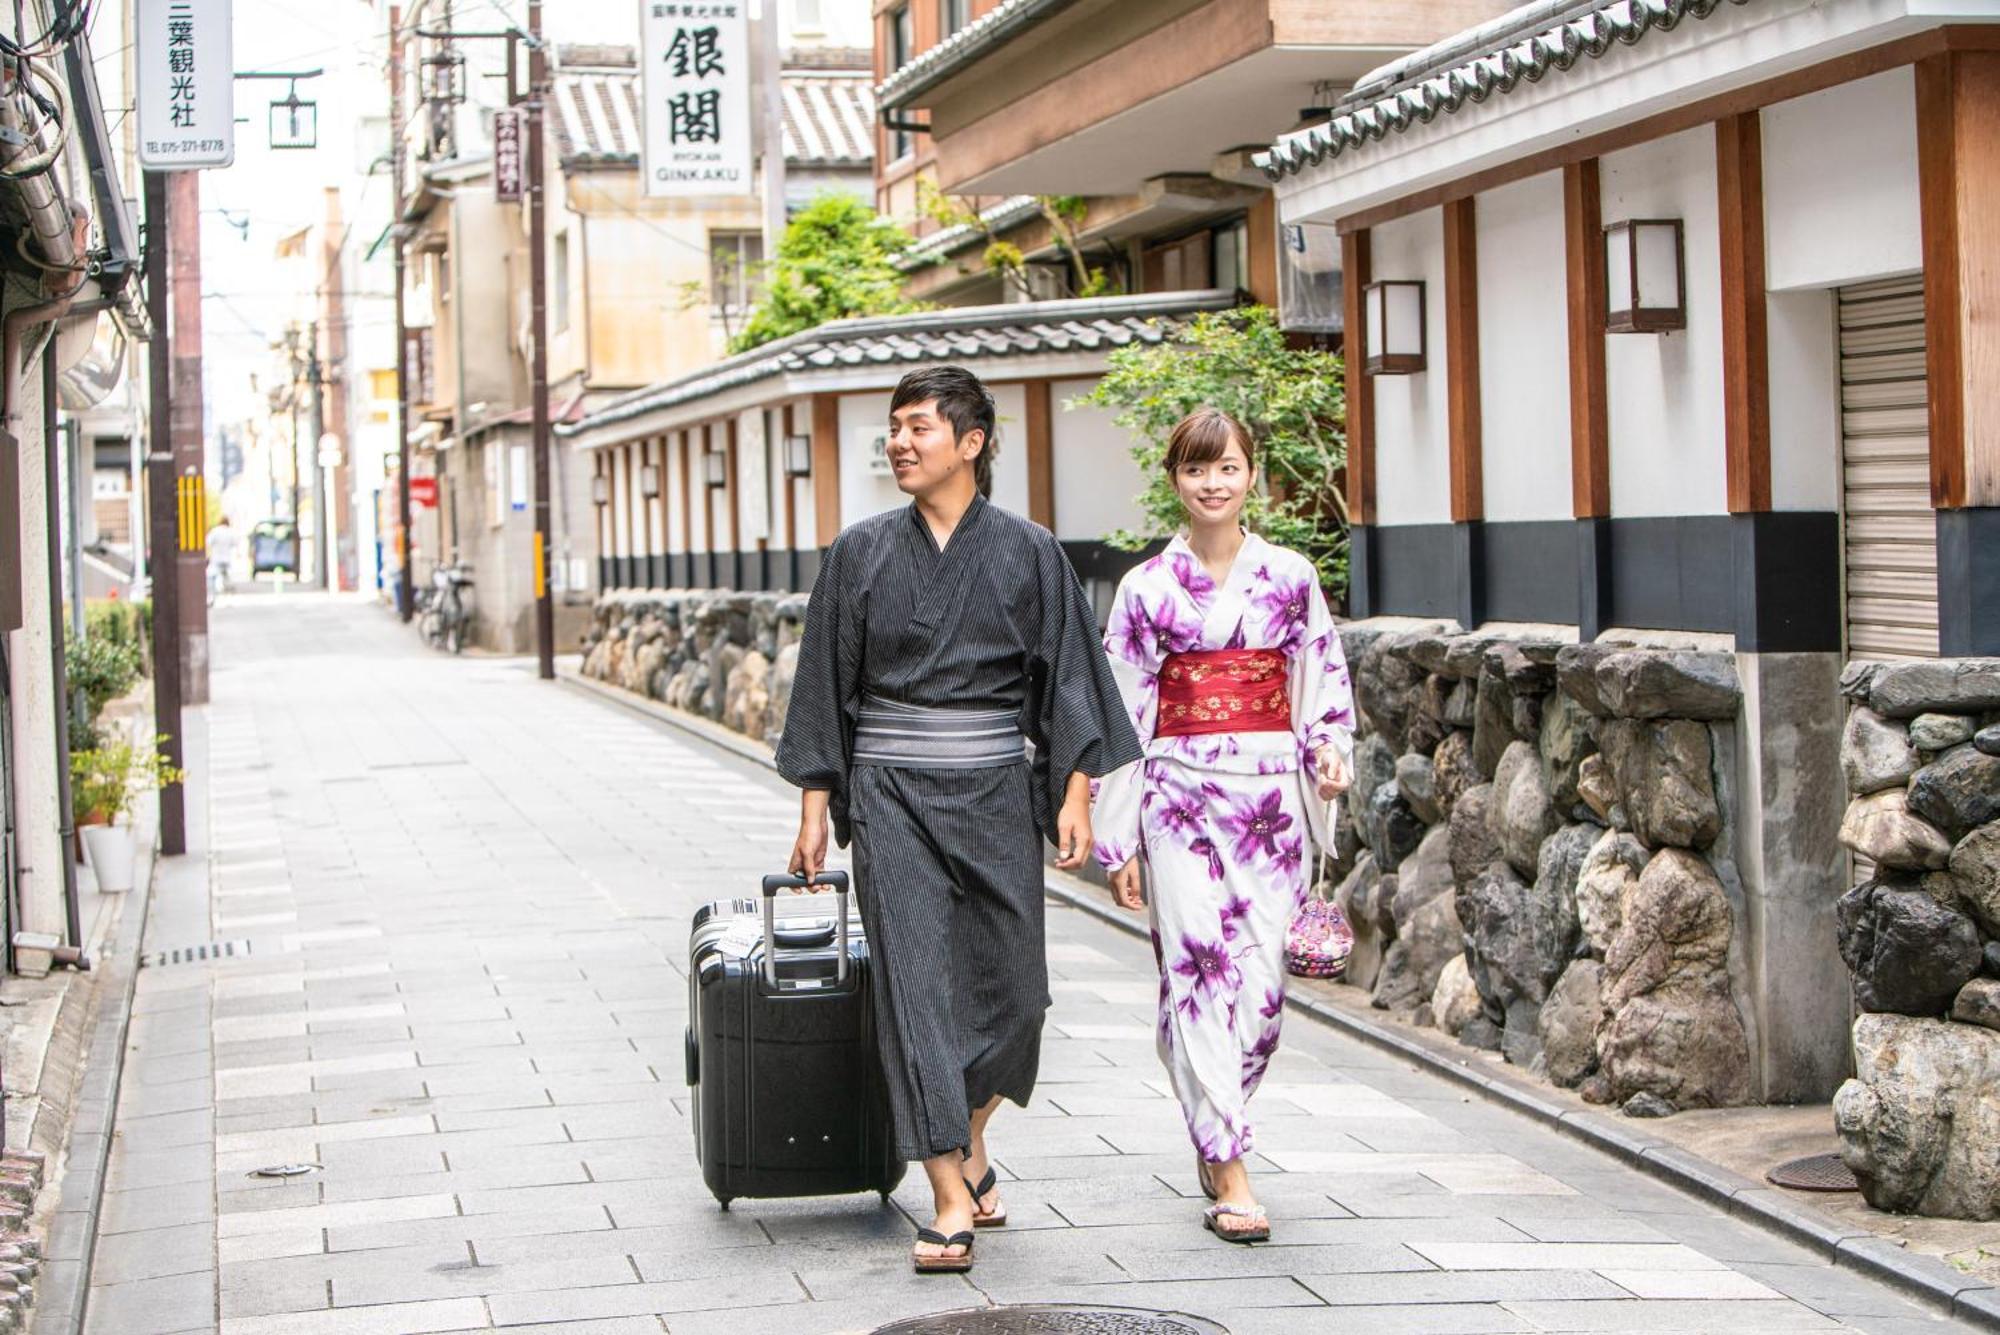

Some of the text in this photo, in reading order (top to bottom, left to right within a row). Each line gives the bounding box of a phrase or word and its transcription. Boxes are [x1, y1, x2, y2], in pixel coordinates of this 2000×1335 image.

[663, 25, 725, 145] 銀閣
[146, 141, 159, 153] TEL
[656, 167, 739, 181] GINKAKU
